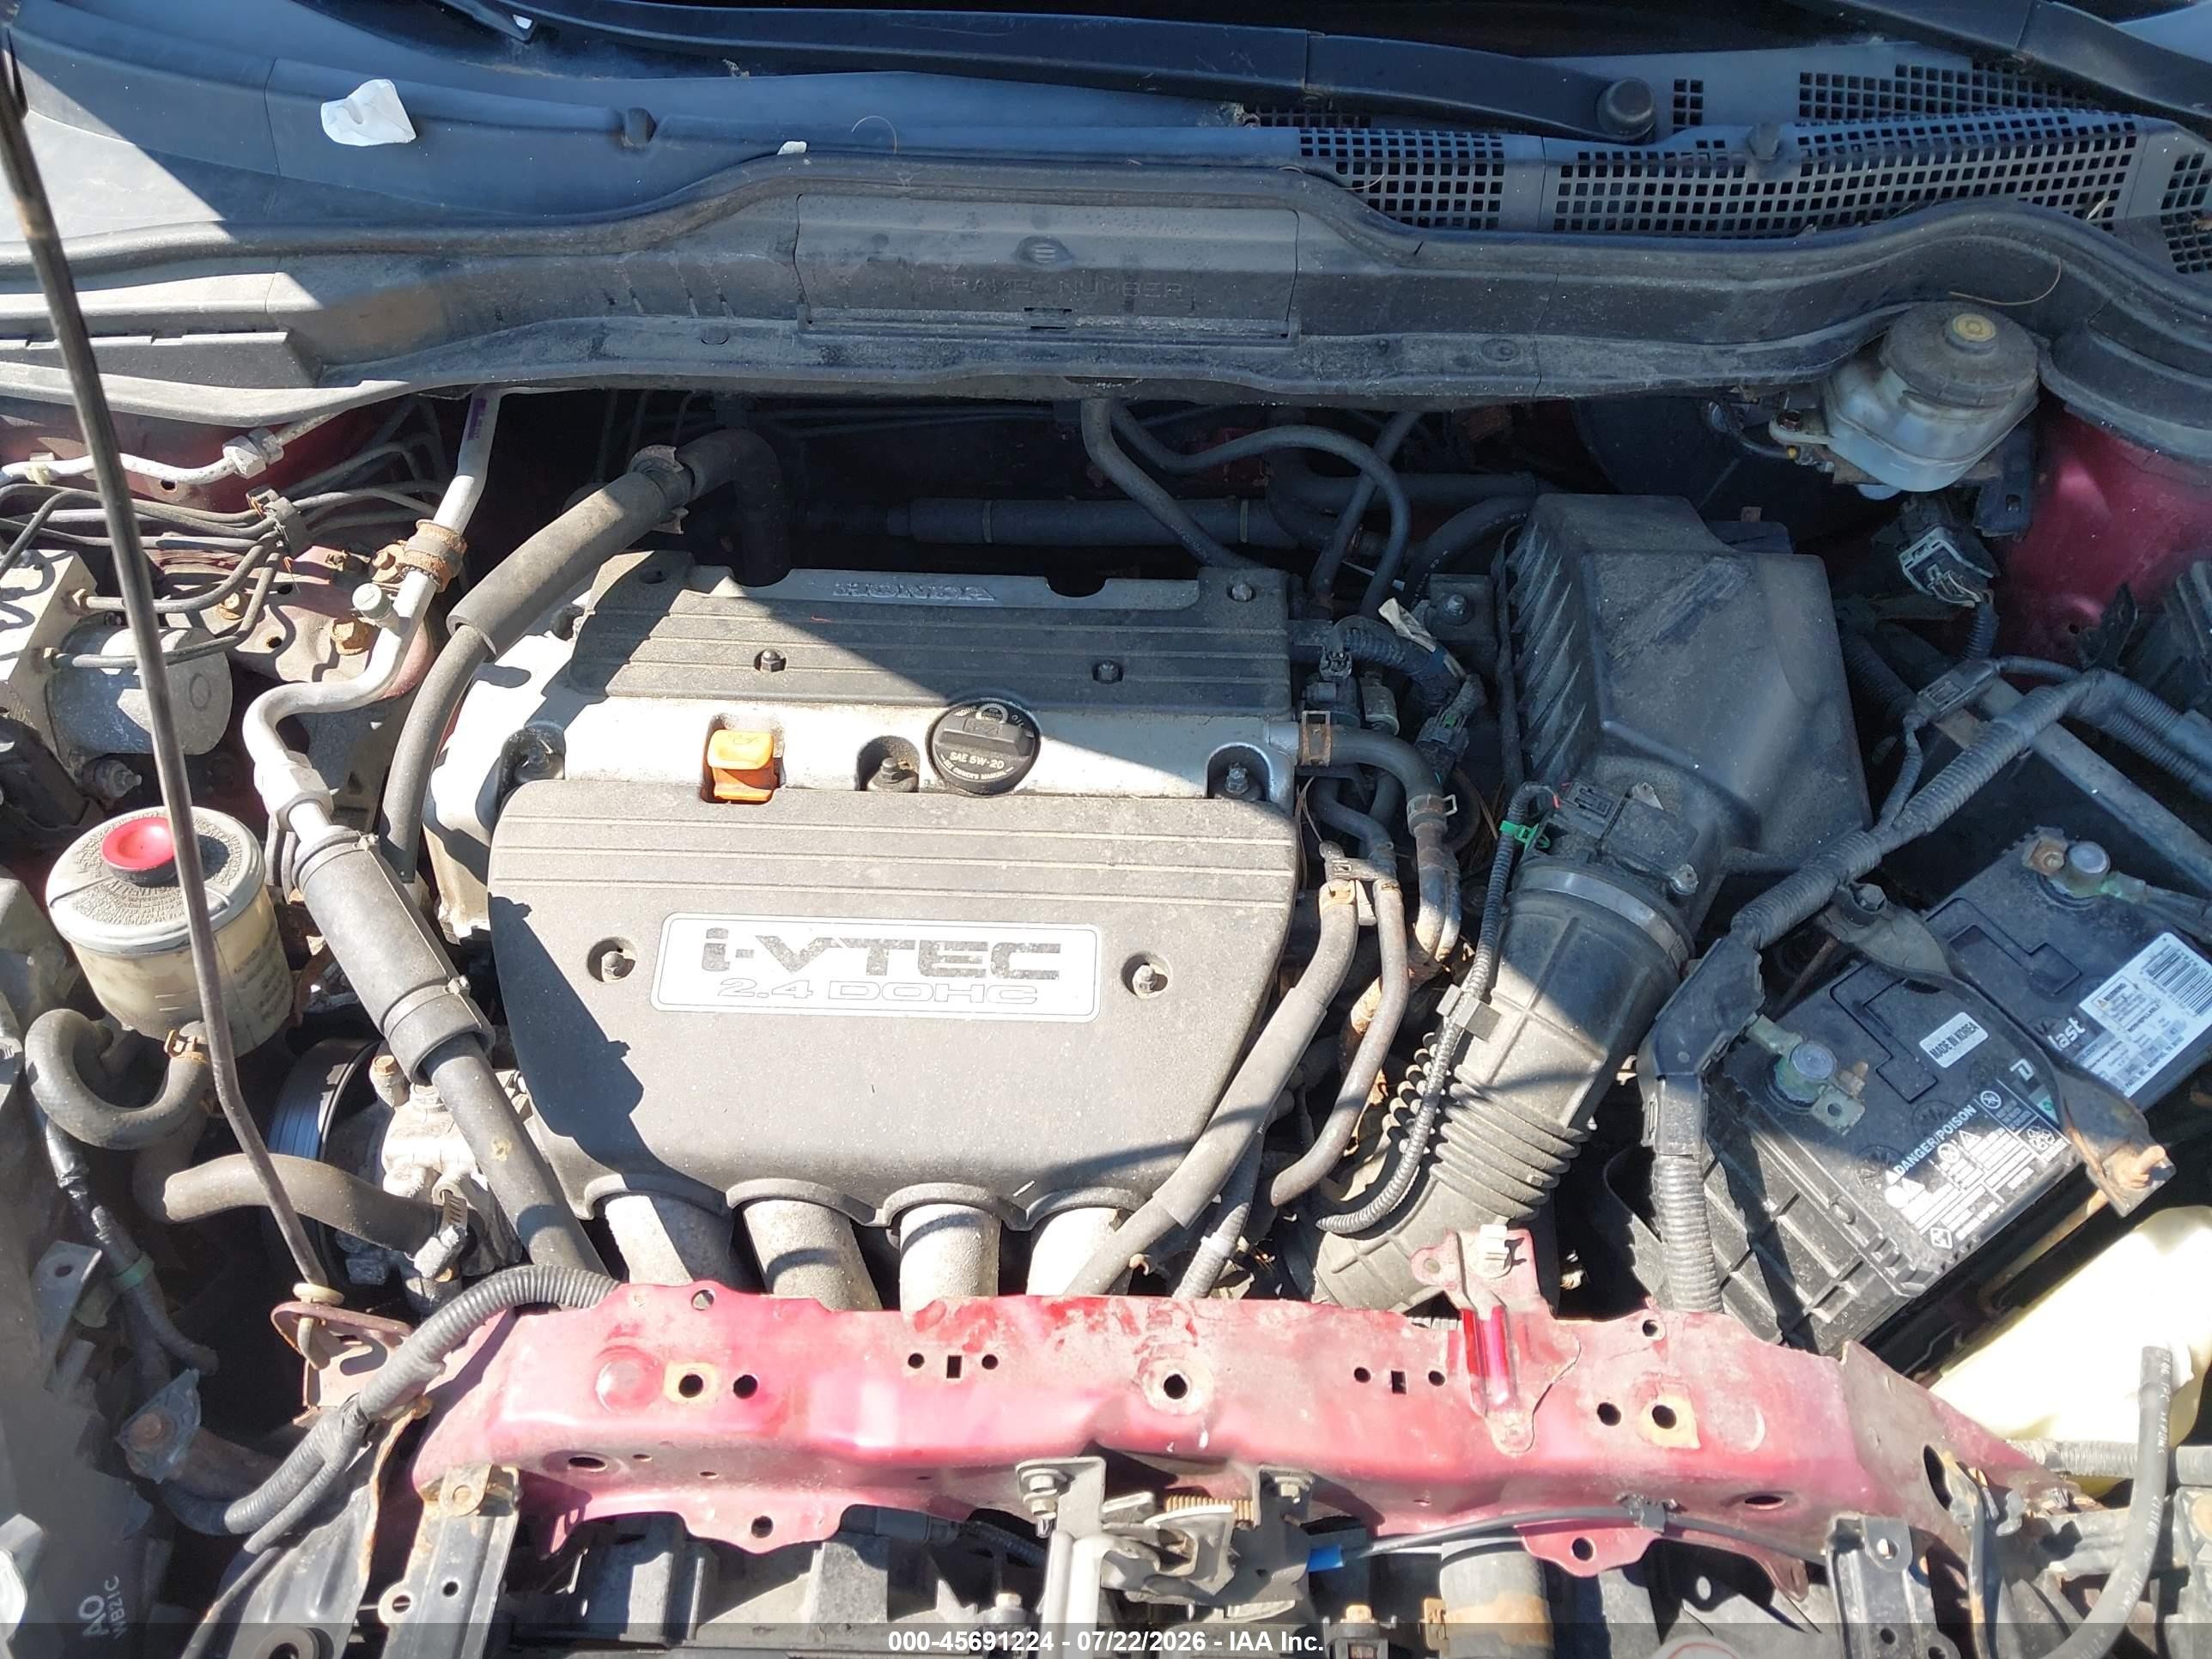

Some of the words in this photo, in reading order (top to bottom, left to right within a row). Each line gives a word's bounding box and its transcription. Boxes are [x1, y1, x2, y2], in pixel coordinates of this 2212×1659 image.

[927, 276, 1031, 295] FRAME
[1058, 275, 1183, 298] NUMBER
[1012, 714, 1024, 728] OIL
[949, 751, 969, 763] SAE
[701, 927, 1061, 981] i-VTEC
[717, 977, 813, 1000] 2.4
[827, 980, 1039, 1006] DOHC
[1929, 1036, 1953, 1060] MADE
[1955, 1021, 1981, 1042] KOREA
[1892, 1103, 1978, 1176] DANGER/POISON
